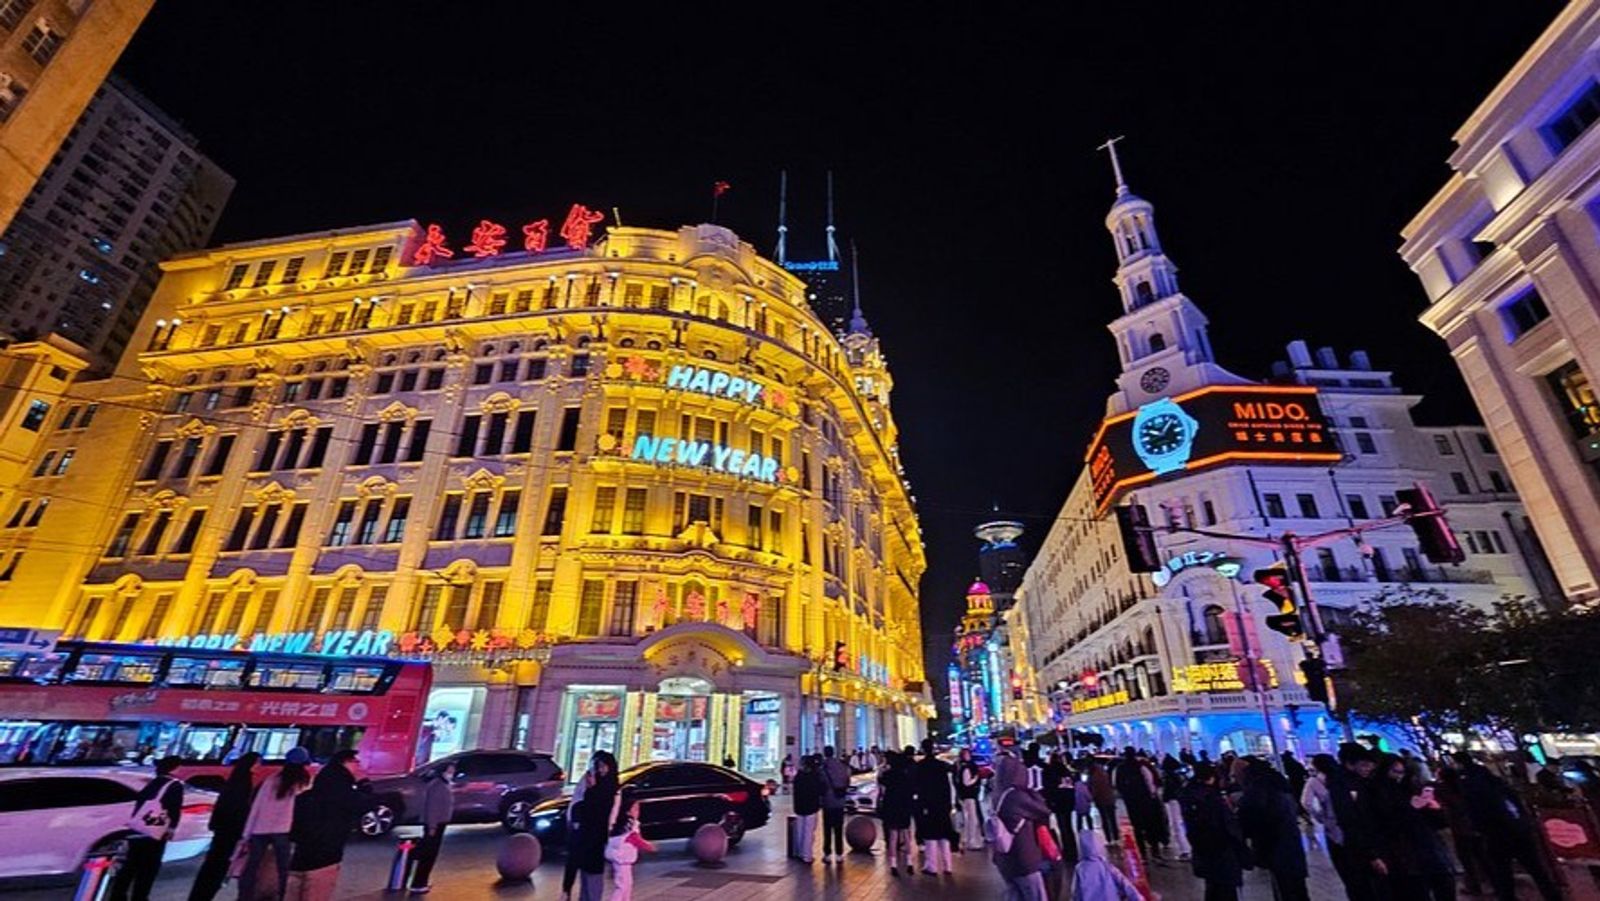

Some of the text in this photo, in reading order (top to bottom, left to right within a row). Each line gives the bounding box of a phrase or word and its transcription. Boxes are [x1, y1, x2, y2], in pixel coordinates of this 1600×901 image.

[668, 365, 762, 403] HAPPY
[632, 435, 779, 482] NEW YEAR
[250, 631, 314, 653] NEW
[320, 630, 393, 656] YEAR
